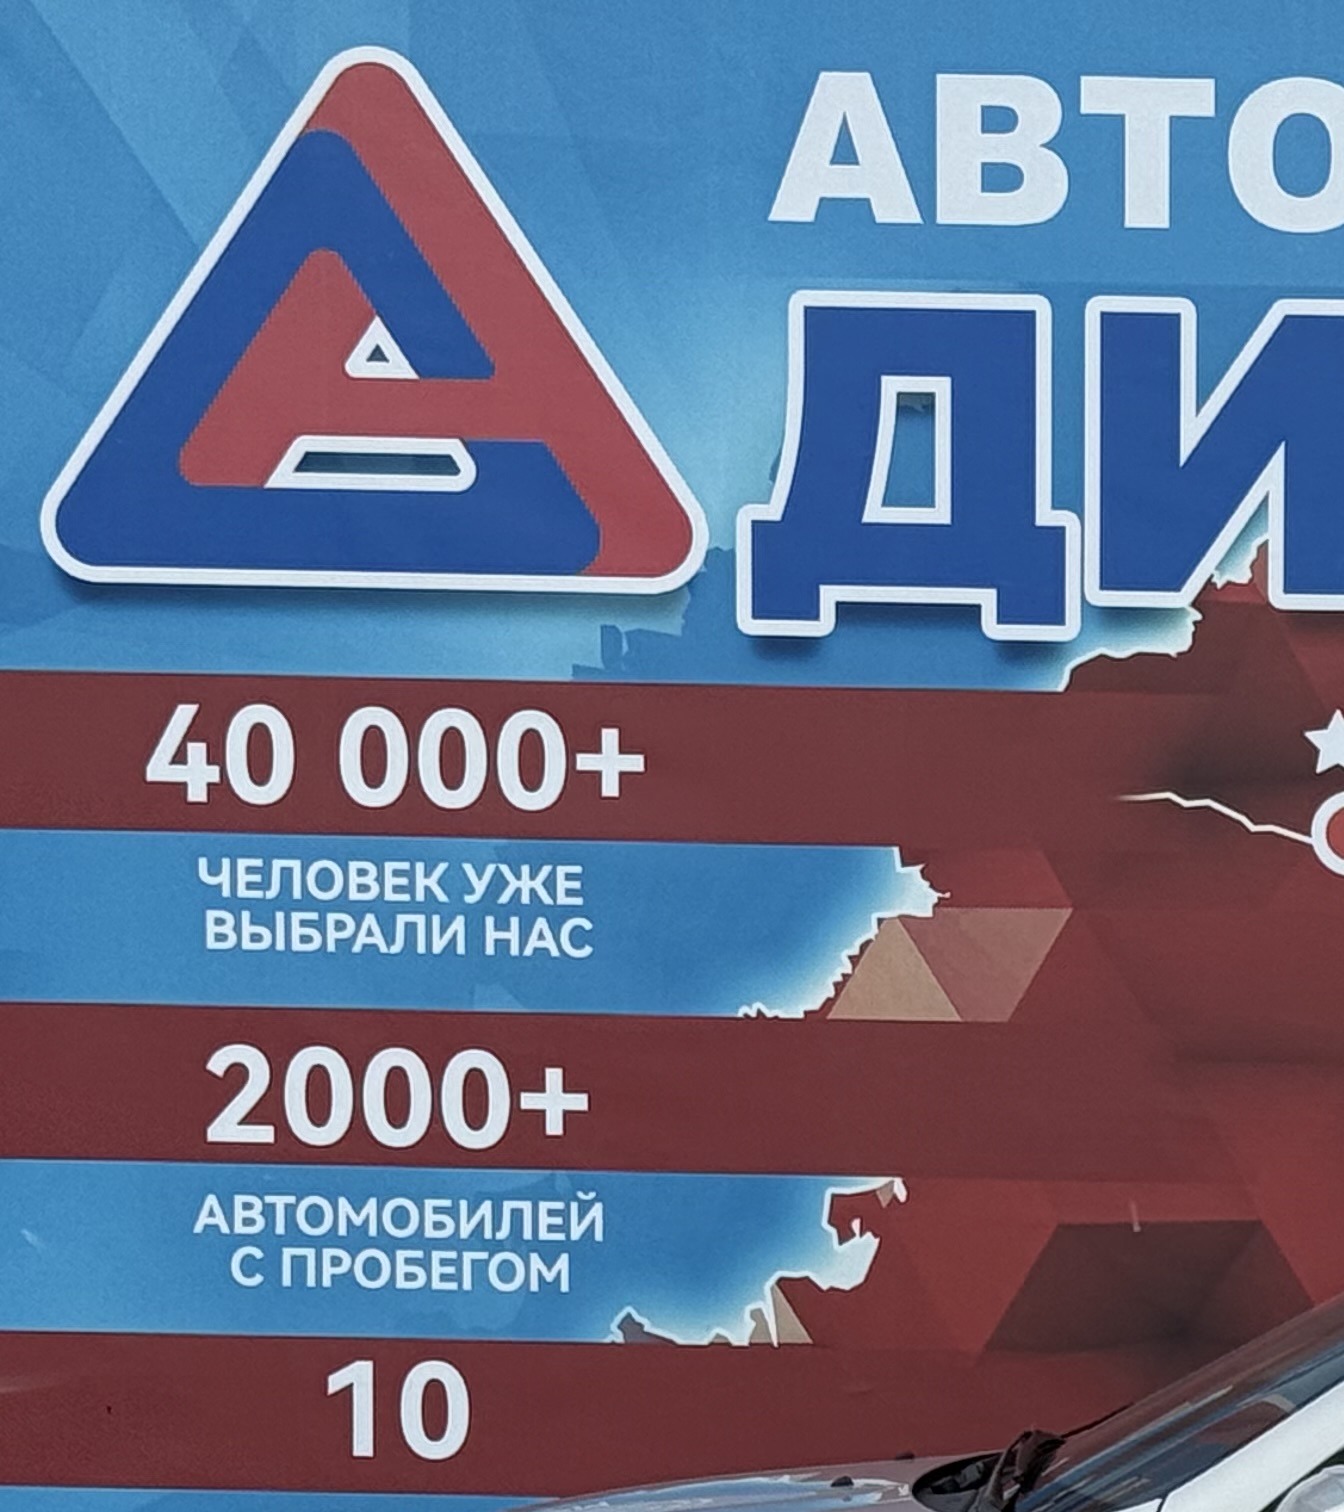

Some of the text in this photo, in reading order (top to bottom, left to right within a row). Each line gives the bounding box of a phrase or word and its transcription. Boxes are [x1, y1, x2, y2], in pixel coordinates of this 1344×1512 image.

[146, 703, 646, 812] 40 000+
[199, 857, 585, 906] ЧЕЛОВЕК УЖЕ
[206, 910, 594, 960] ВЫБРАЛИ НАС
[207, 1043, 590, 1151] 2000+
[194, 1190, 605, 1242] АВТОМОБИЛЕЙ
[231, 1246, 571, 1293] С ПРОБЕГОМ
[327, 1360, 471, 1461] 10
